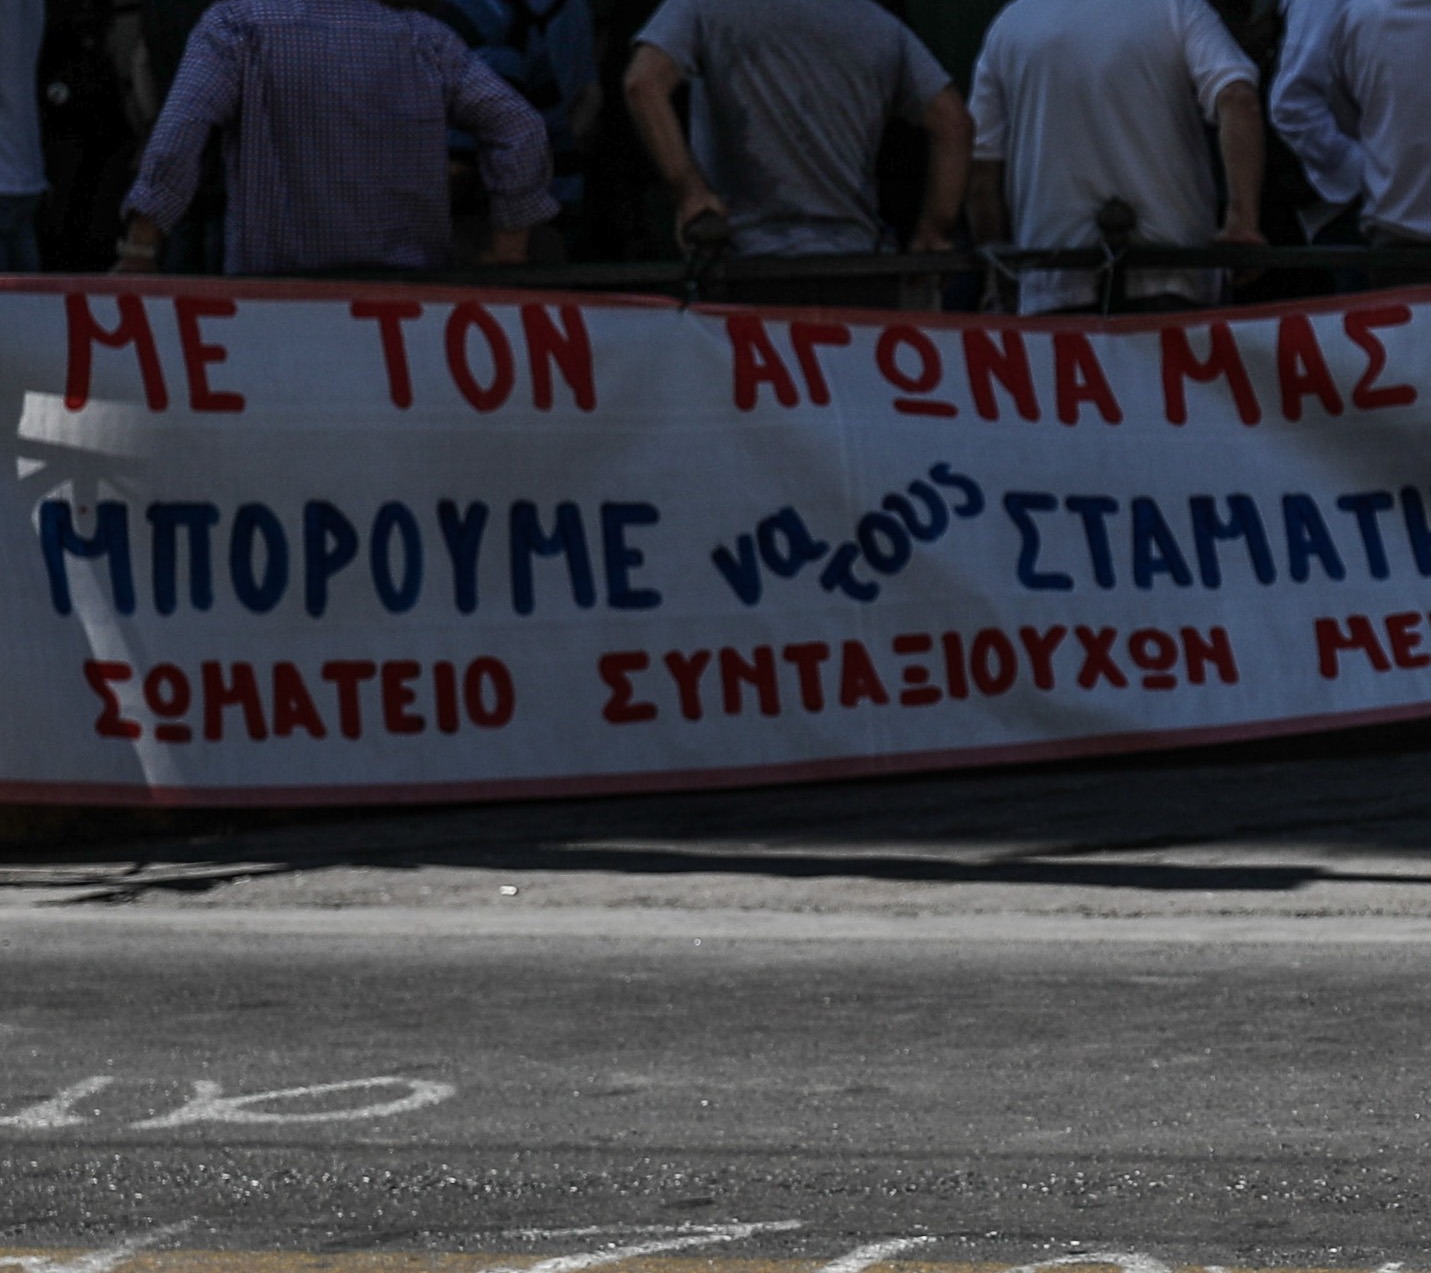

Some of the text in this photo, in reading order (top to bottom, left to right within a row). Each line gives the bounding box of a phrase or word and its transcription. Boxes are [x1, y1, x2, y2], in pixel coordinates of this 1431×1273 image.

[63, 292, 246, 413] ΜΕ
[349, 299, 598, 414] ΤΟΝ
[1160, 304, 1418, 426] ΜΑΣ
[40, 500, 663, 617] ΜΠΟΡΟΥΜΕ
[712, 507, 828, 606] να
[822, 461, 985, 603] τους
[84, 657, 517, 742] ΣΩΜΑΤΕΙΟ
[599, 624, 1238, 722] ΣΥΝΤΑΞΙΟΥΧΩΝ
